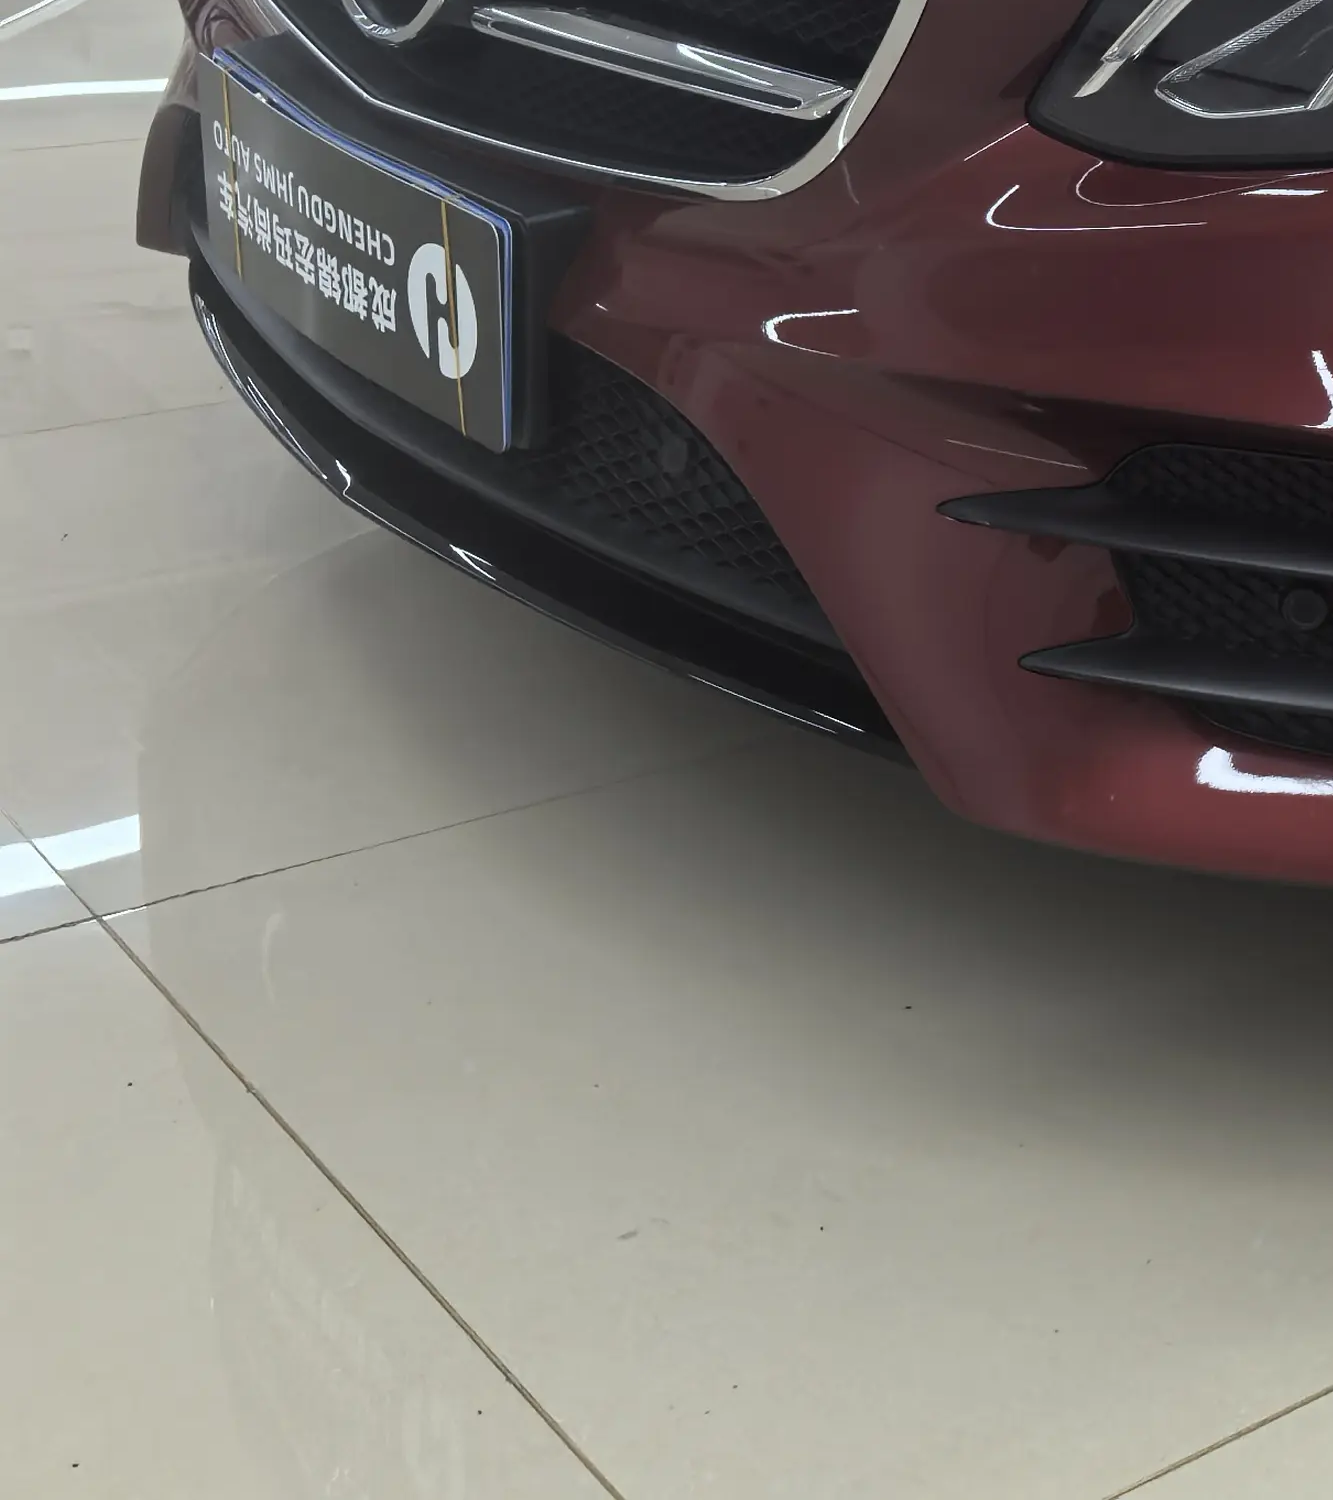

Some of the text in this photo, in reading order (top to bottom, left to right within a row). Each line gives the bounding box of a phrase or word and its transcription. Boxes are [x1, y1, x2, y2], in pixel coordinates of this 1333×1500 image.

[213, 120, 396, 266] CHENGDU JHMS AUTO
